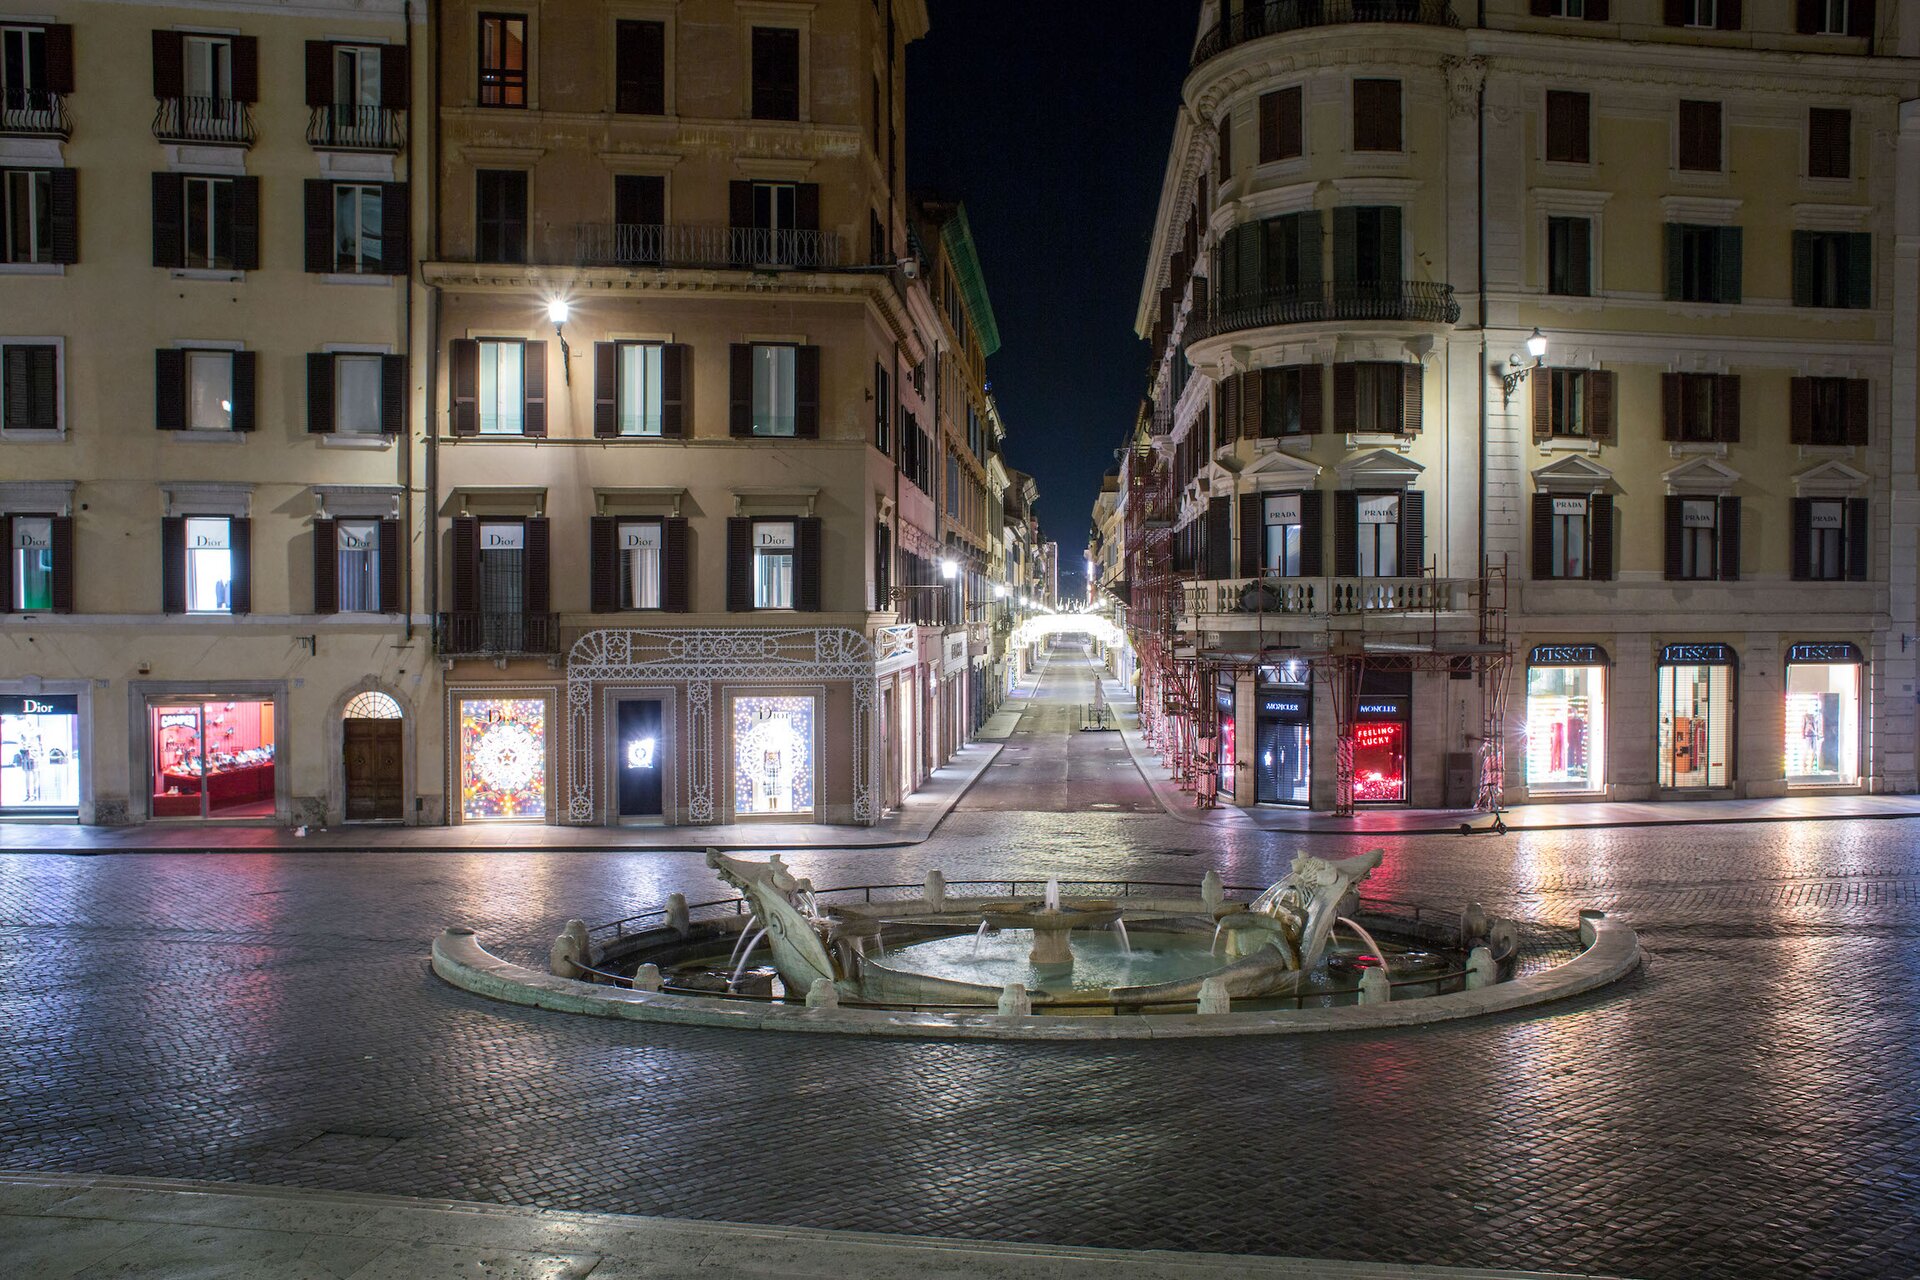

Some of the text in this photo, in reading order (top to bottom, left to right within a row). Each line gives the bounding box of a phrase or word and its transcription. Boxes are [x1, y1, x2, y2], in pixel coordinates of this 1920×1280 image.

[22, 535, 46, 546] Dior
[197, 535, 222, 547] Dior
[346, 536, 371, 548] Dior
[490, 534, 515, 546] Dior
[628, 534, 653, 546] Dior
[762, 533, 786, 545] Dior
[23, 699, 53, 713] Dior
[1357, 726, 1394, 737] FEELING
[1362, 736, 1389, 746] LUCKY
